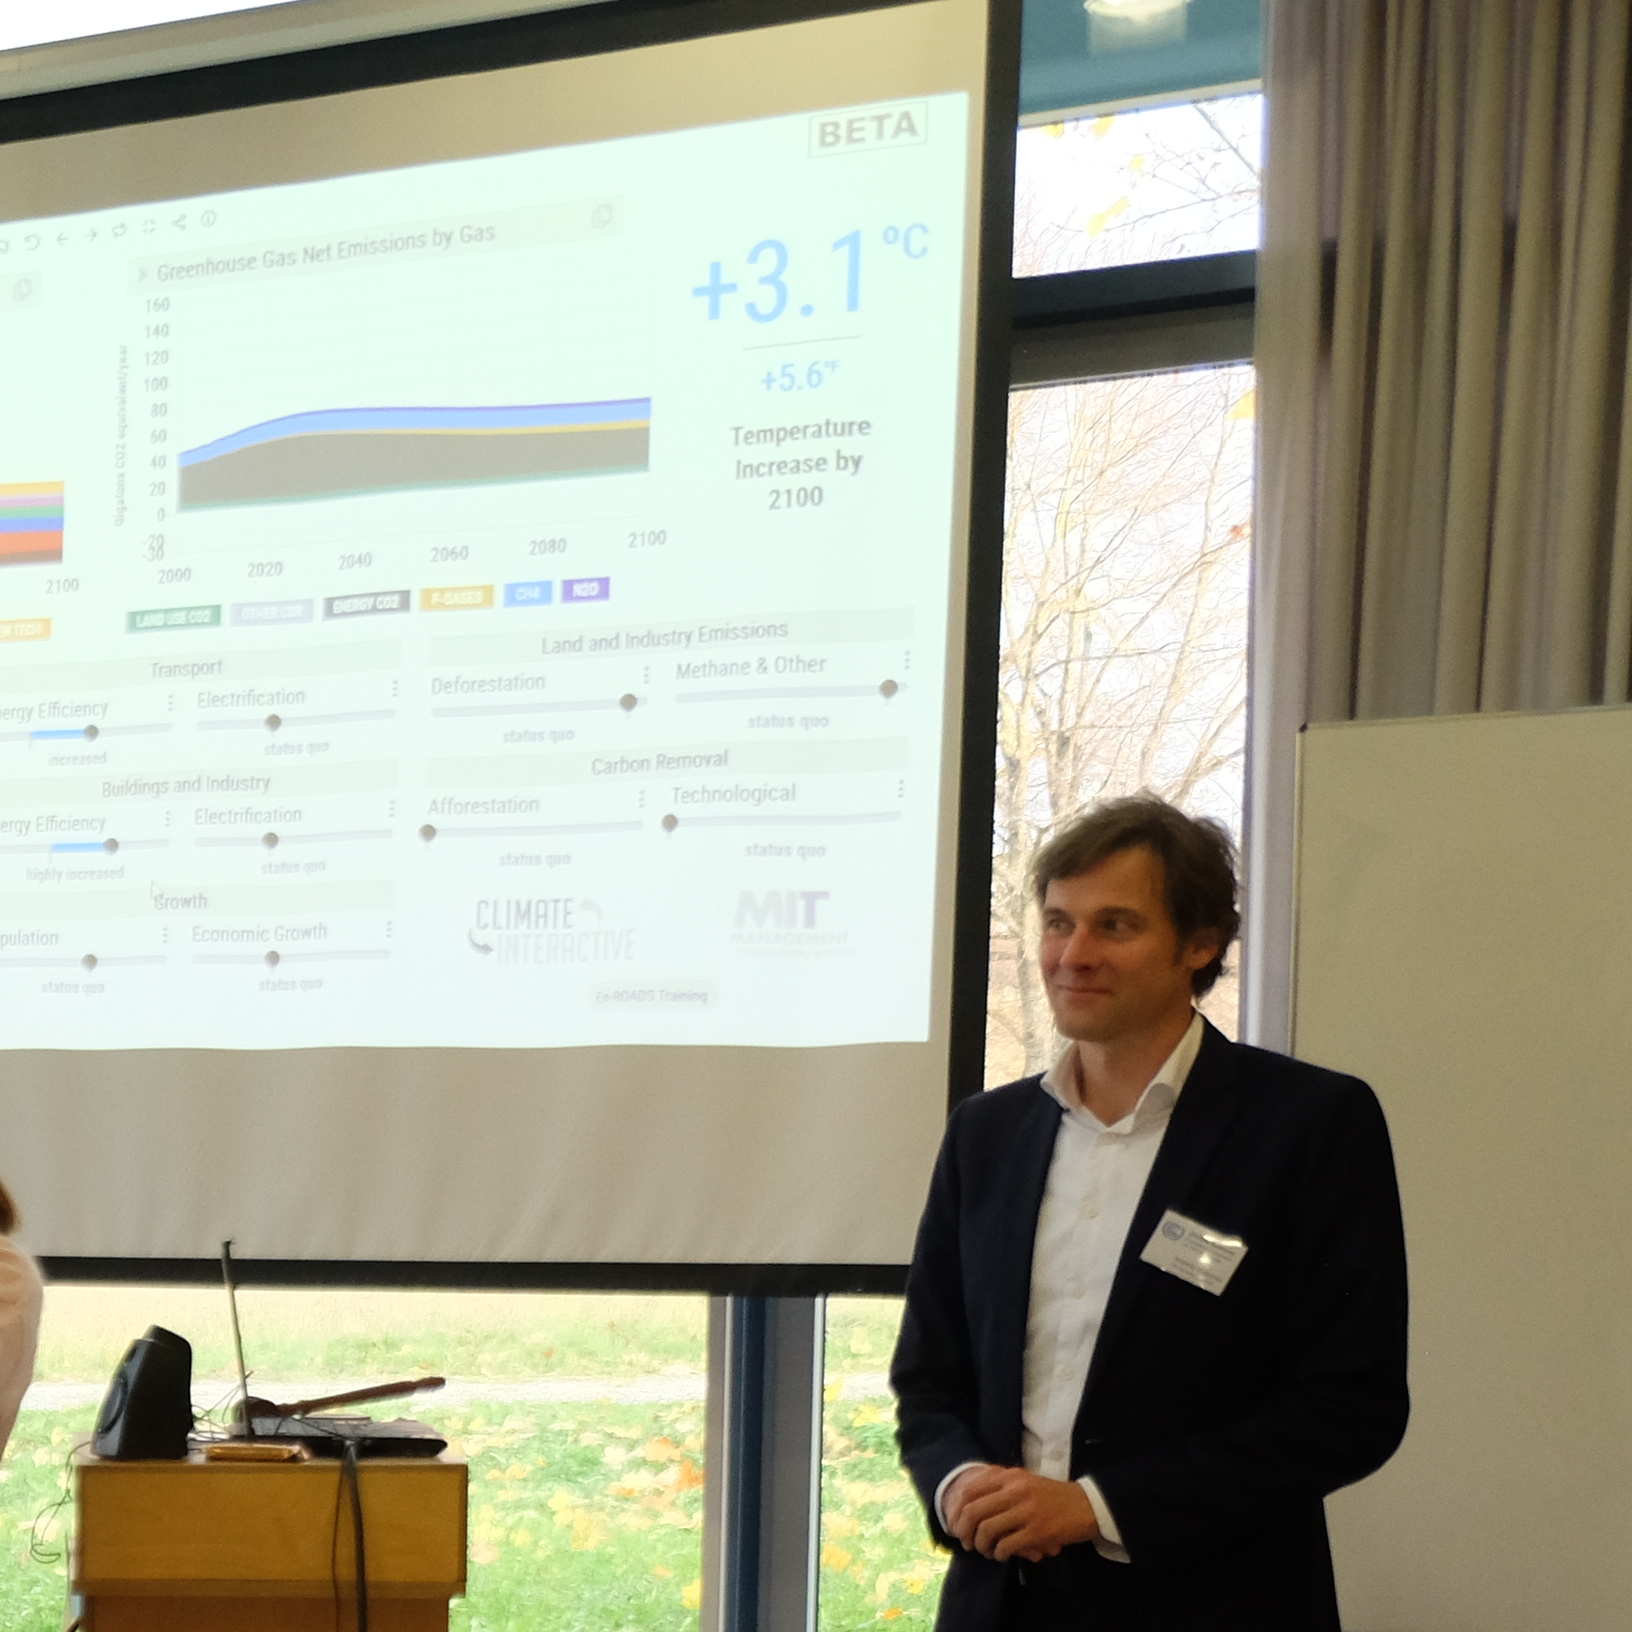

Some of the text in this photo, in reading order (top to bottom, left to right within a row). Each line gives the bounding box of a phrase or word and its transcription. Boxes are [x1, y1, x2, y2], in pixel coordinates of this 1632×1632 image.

[818, 110, 918, 149] BETA
[157, 225, 495, 283] Greenhouse Gas Net Emissions by Gas
[145, 297, 170, 313] 160
[145, 324, 170, 340] 140
[144, 350, 169, 366] 120
[144, 376, 168, 392] 100
[150, 403, 167, 418] 80
[150, 429, 167, 444] 60
[730, 418, 872, 447] Temperature
[149, 455, 166, 470] 40
[736, 451, 864, 480] Increase by
[148, 481, 166, 496] 20
[768, 486, 824, 510] 2100
[528, 538, 567, 556] 2080
[628, 530, 667, 548] 2100
[338, 553, 372, 570] 2040
[430, 545, 469, 563] 2060
[157, 567, 192, 584] 2000
[247, 562, 283, 578] 2020
[45, 577, 79, 594] 2100
[541, 622, 789, 656] Land and Industry Emissions
[151, 659, 223, 679] Transport
[676, 655, 827, 680] Methane & Other
[431, 673, 546, 696] Deforestation
[197, 689, 305, 708] Electrification
[38, 700, 108, 720] Efficiency
[747, 714, 829, 731] status quo
[503, 729, 575, 744] status quo
[264, 740, 329, 756] status quo
[592, 750, 729, 776] Carbon Removal
[102, 775, 271, 798] Buildings and Industry
[672, 783, 796, 805] Technological
[428, 797, 540, 815] Afforestation
[36, 814, 106, 834] Efficiency
[194, 807, 302, 826] Electrification
[154, 893, 207, 911] Growth
[733, 890, 831, 929] MIT
[476, 898, 574, 930] CLIMATE
[191, 923, 327, 943] Economic Growth
[497, 928, 636, 966] INTERACTIVE
[659, 988, 708, 1004] Training
